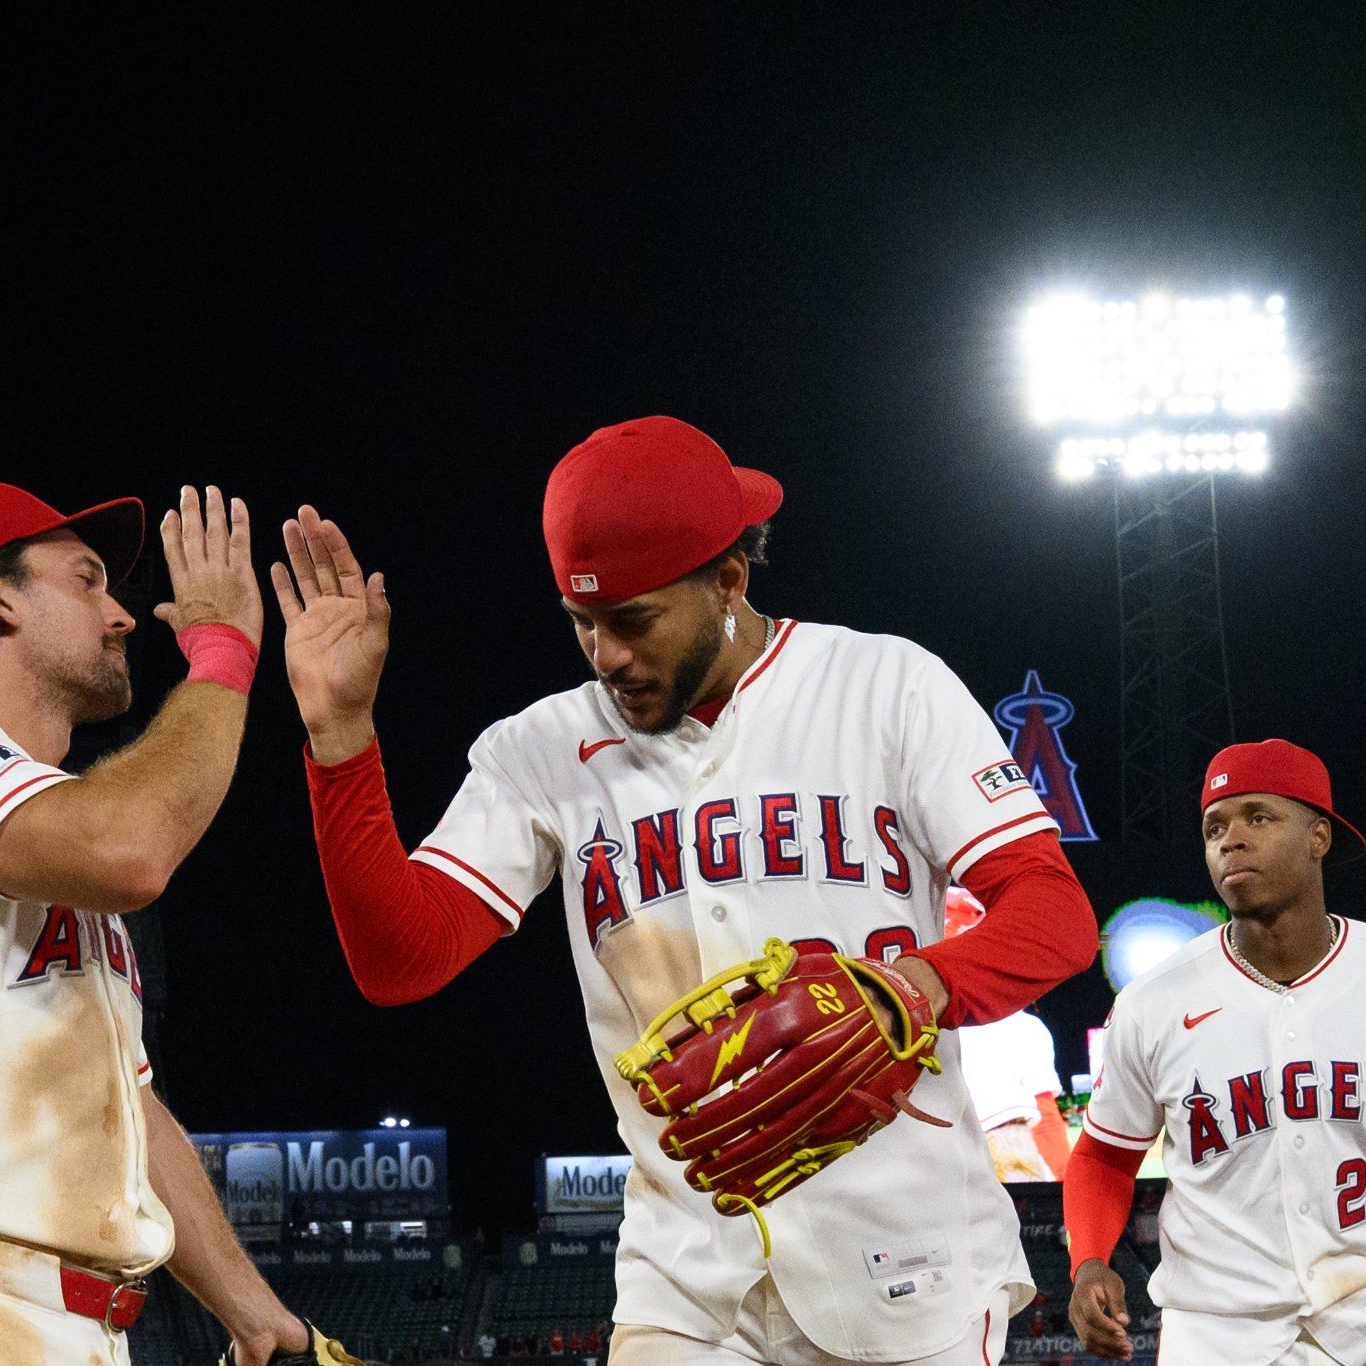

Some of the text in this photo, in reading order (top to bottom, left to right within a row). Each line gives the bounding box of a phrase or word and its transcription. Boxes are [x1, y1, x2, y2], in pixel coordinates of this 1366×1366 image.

[577, 792, 914, 952] ANGELS
[808, 982, 845, 1015] 22
[286, 1141, 435, 1193] Modelo
[562, 1166, 628, 1196] Mode
[393, 1247, 431, 1261] Modelo
